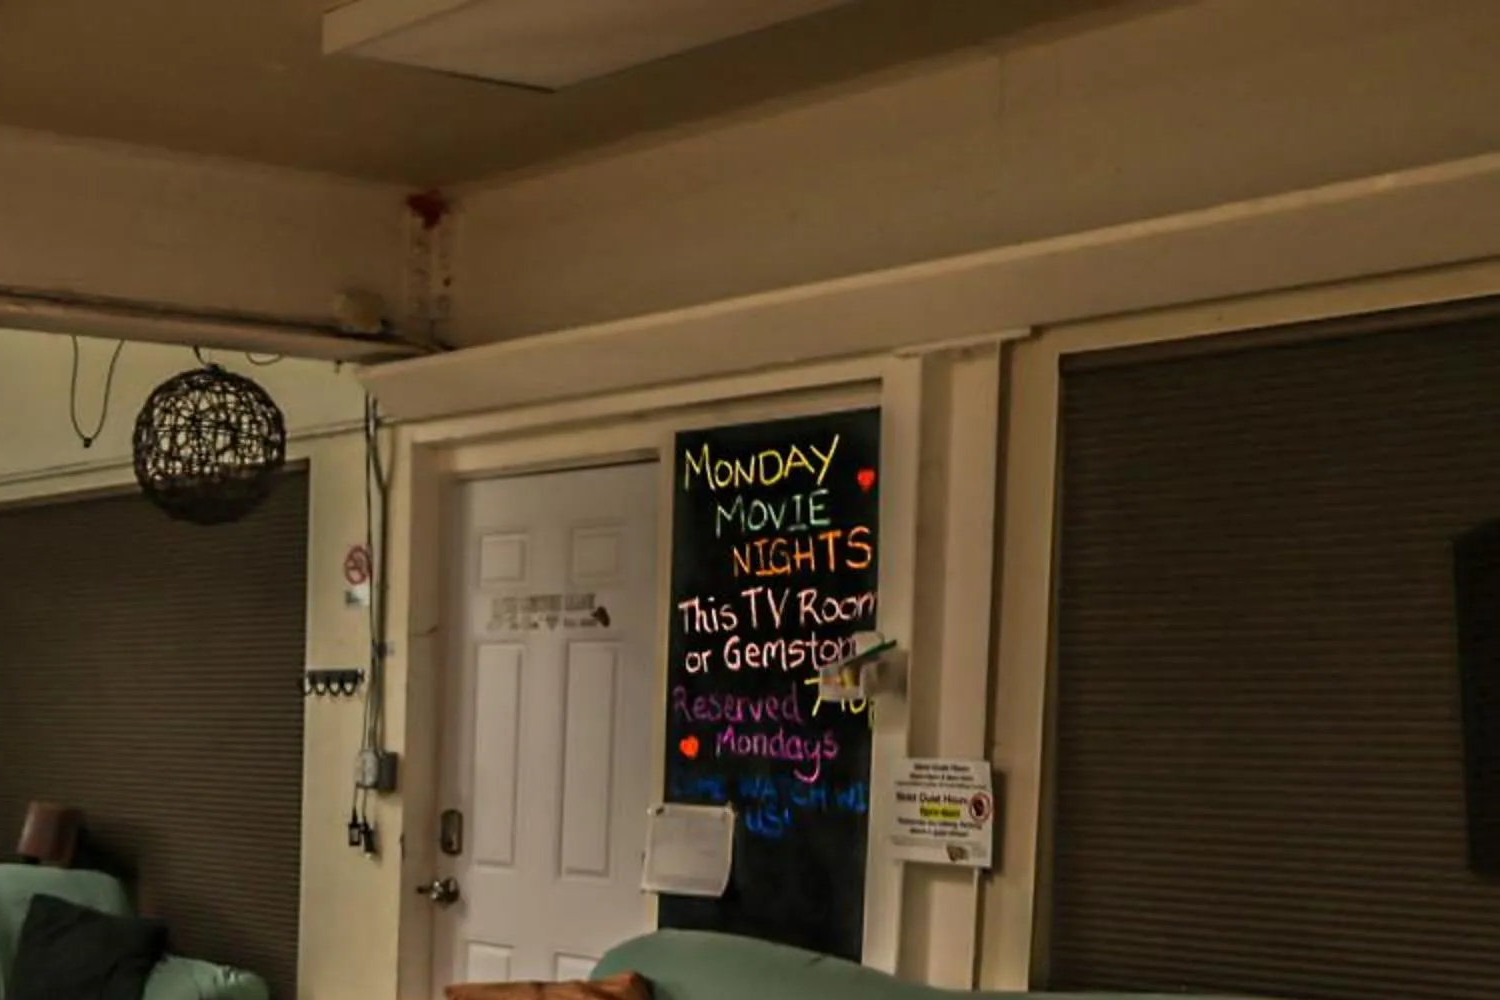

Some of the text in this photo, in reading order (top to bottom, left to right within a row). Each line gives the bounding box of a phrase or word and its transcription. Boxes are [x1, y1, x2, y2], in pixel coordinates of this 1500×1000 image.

[684, 434, 840, 491] MONDAY
[714, 488, 831, 539] MOVIE
[731, 525, 873, 578] NIGHTS
[678, 596, 739, 634] This
[741, 586, 790, 630] TV
[685, 630, 856, 673] or Gemston
[671, 681, 804, 724] Reserved
[715, 724, 841, 783] Mondays
